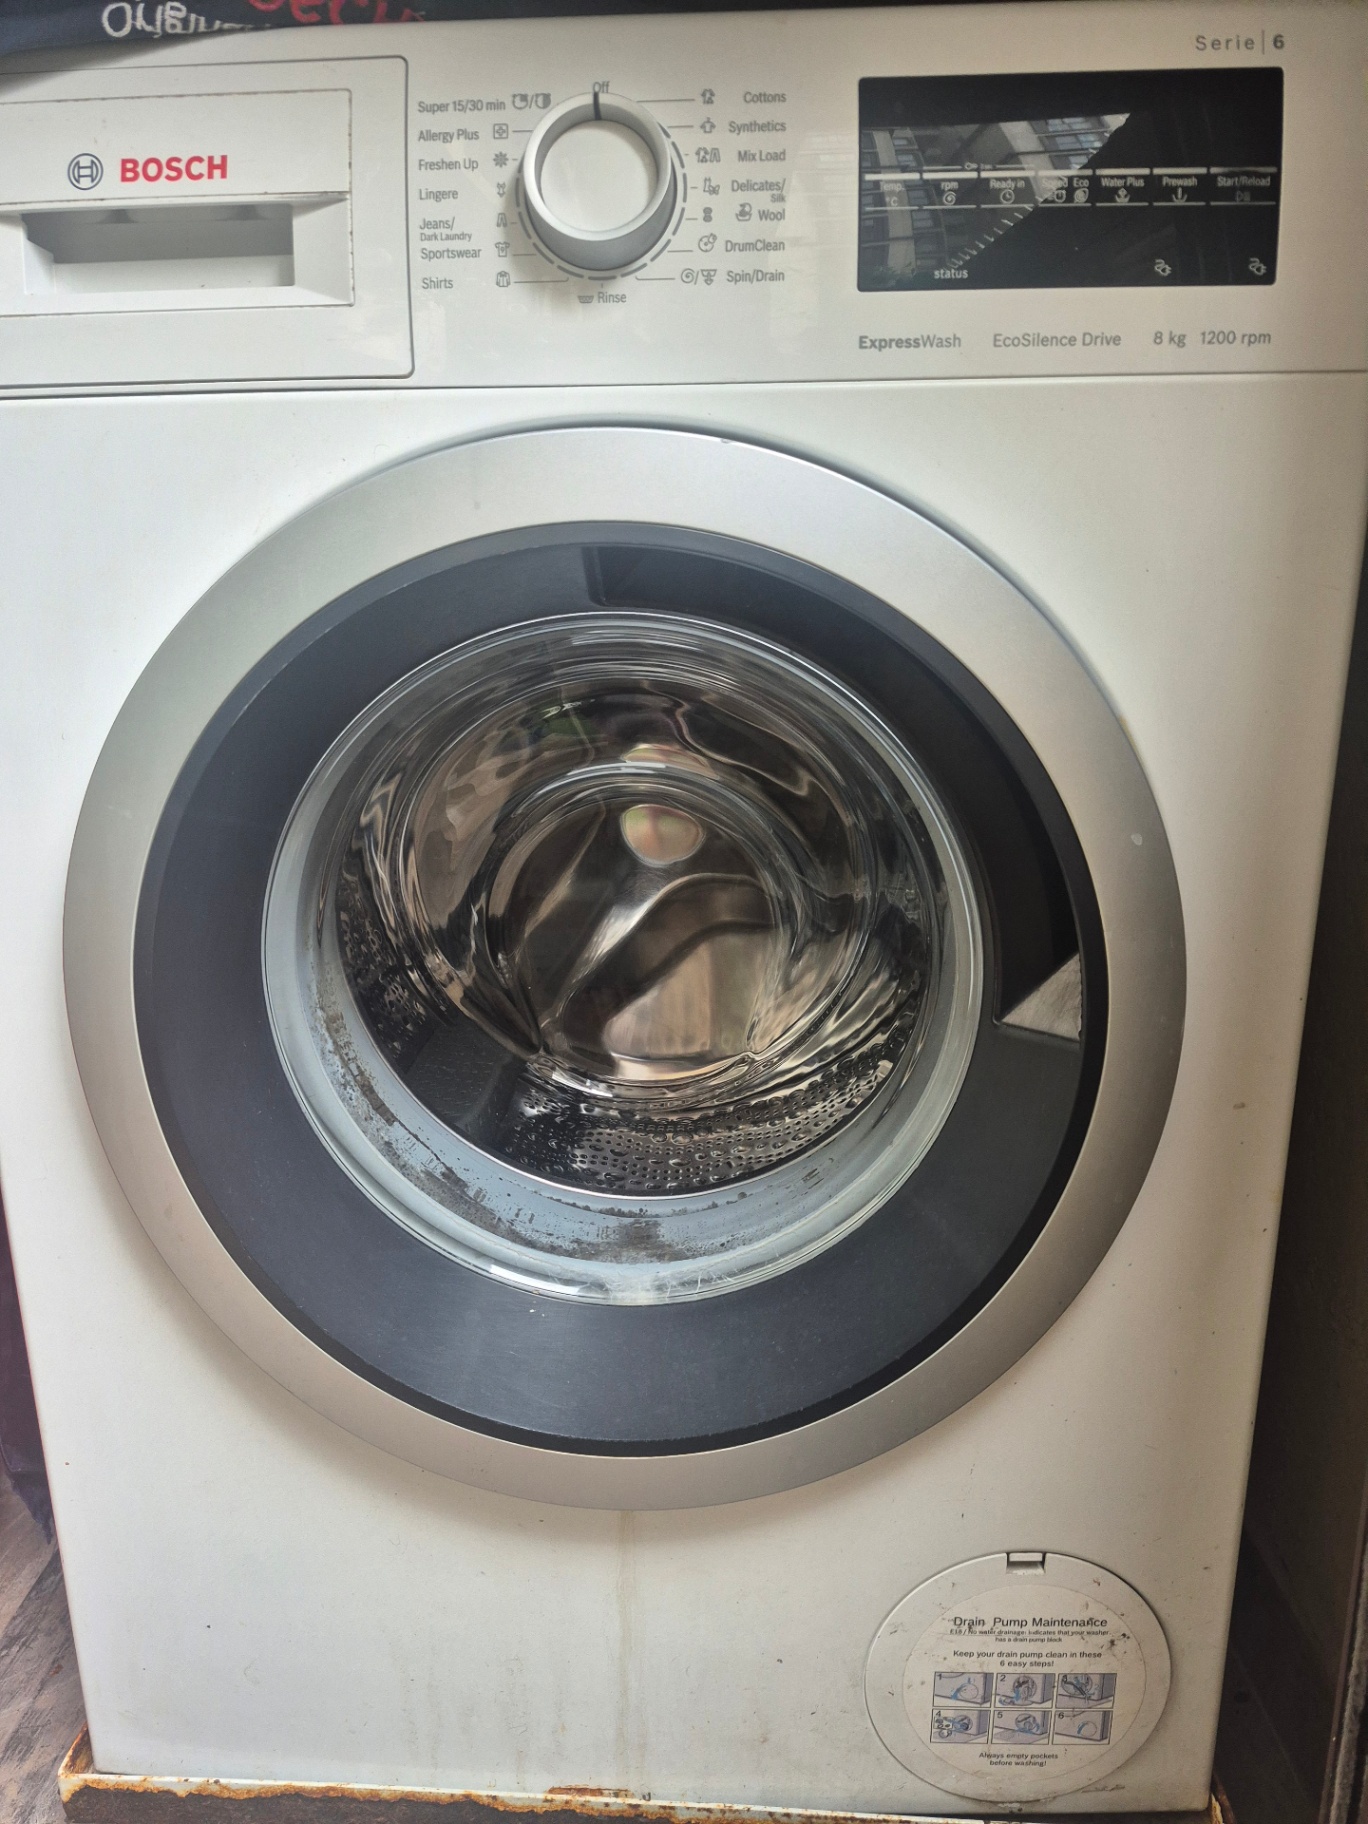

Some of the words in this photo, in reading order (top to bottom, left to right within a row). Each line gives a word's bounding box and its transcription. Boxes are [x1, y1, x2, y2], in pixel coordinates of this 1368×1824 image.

[1195, 34, 1255, 51] Serie
[1272, 33, 1286, 51] 6
[593, 81, 610, 94] Off
[743, 91, 787, 103] Cottons
[418, 101, 449, 114] Super
[453, 99, 484, 112] 15/30
[486, 100, 506, 111] min
[728, 121, 787, 135] Synthetics
[418, 130, 454, 144] Allergy
[457, 129, 480, 141] Plus
[738, 150, 757, 162] Mix
[759, 150, 786, 161] Load
[119, 154, 228, 182] BOSCH
[418, 159, 461, 170] Freshen
[464, 158, 479, 172] Up
[731, 179, 786, 192] Delicates/
[941, 181, 959, 191] rpm
[990, 179, 1016, 189] Ready
[1017, 178, 1025, 188] in
[1073, 177, 1089, 187] Eco
[1101, 177, 1126, 187] Water
[1126, 177, 1145, 187] Plus
[1162, 176, 1198, 186] Prewash
[1217, 175, 1271, 187] Start/Reload
[419, 188, 459, 202] Lingere
[770, 193, 786, 203] Silk
[758, 209, 785, 221] Wool
[419, 217, 455, 230] Jeans/
[420, 232, 439, 242] Dark
[440, 232, 472, 243] Laundry
[725, 240, 785, 252] DrumClean
[420, 247, 482, 260] Sportswear
[726, 270, 785, 284] Spin/Drain
[934, 267, 969, 280] status
[421, 277, 454, 290] Shirts
[597, 292, 627, 304] Rinse
[858, 333, 962, 352] ExpressWash
[993, 332, 1078, 348] EcoSilence
[1082, 332, 1123, 347] Drive
[1153, 331, 1164, 345] 8
[1168, 331, 1187, 349] kg
[1200, 330, 1236, 345] 1200
[1241, 333, 1272, 349] rpm
[953, 1616, 985, 1627] Drain
[993, 1616, 1028, 1629] Pump
[1031, 1616, 1107, 1628] Maintenance
[953, 1650, 975, 1659] Keep
[976, 1651, 995, 1660] your
[997, 1650, 1018, 1659] drain
[1019, 1651, 1043, 1660] pump
[1045, 1650, 1067, 1659] clean
[1069, 1650, 1077, 1659] in
[1079, 1650, 1103, 1659] these
[1000, 1660, 1005, 1668] 6
[1007, 1660, 1027, 1669] easy
[1029, 1660, 1055, 1669] steps!
[1000, 1673, 1006, 1682] 2
[997, 1711, 1003, 1719] 5
[979, 1752, 1004, 1761] Always
[1006, 1753, 1029, 1761] empty
[1030, 1752, 1059, 1760] pockets
[989, 1759, 1014, 1767] before
[1014, 1759, 1047, 1768] washing!
